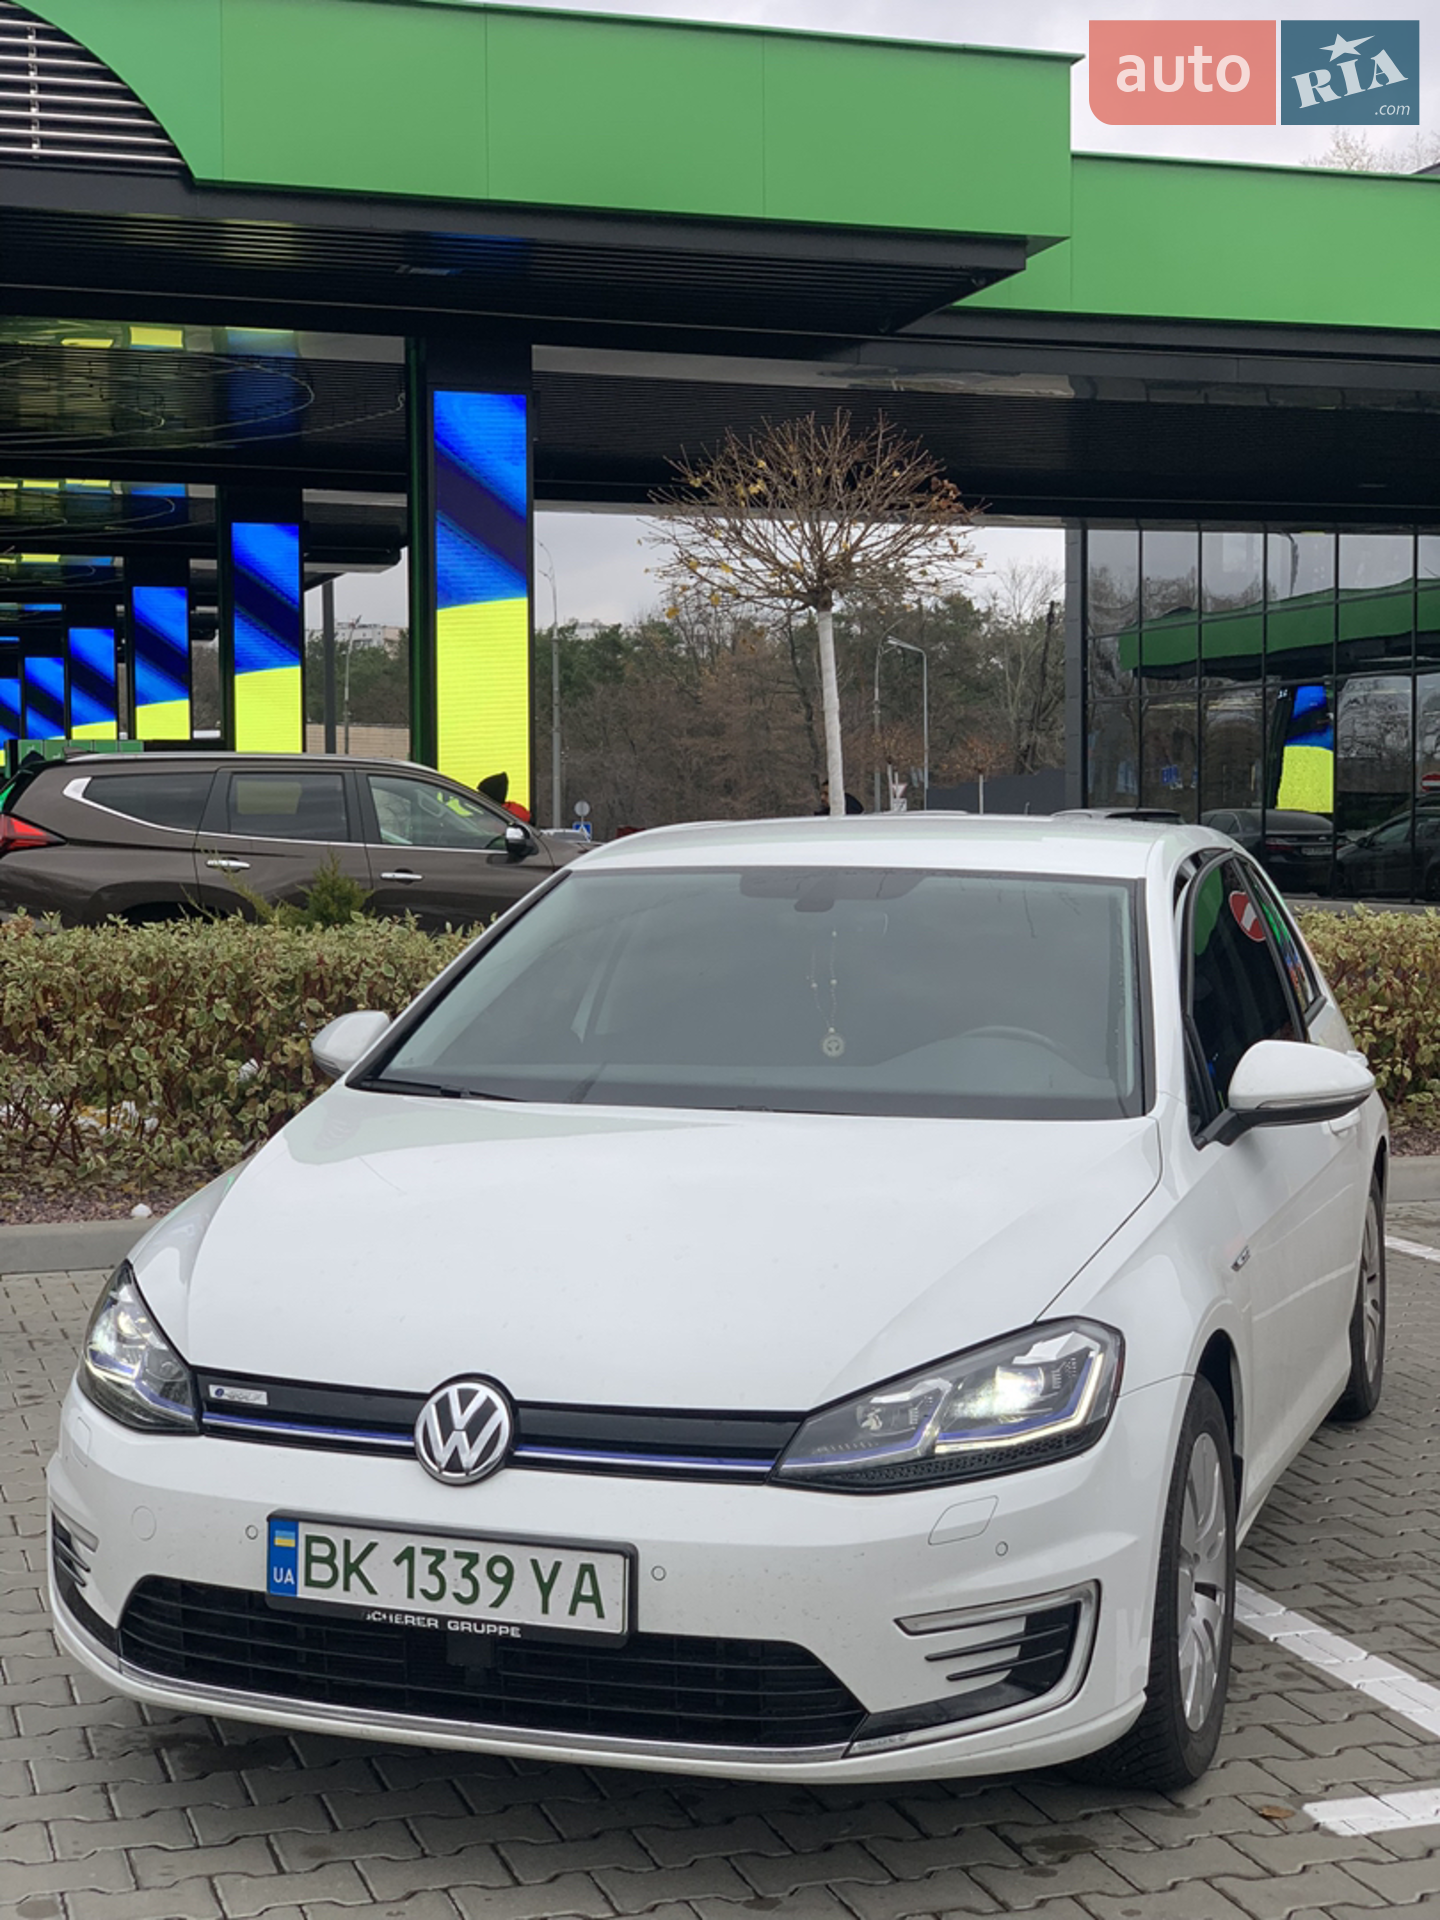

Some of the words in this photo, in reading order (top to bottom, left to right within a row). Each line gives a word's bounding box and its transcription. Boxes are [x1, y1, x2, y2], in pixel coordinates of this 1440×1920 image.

[272, 1566, 295, 1585] UA
[304, 1534, 379, 1596] BK
[393, 1546, 515, 1609] 1339
[530, 1558, 606, 1619] YA
[447, 1620, 522, 1638] GRUPPE
